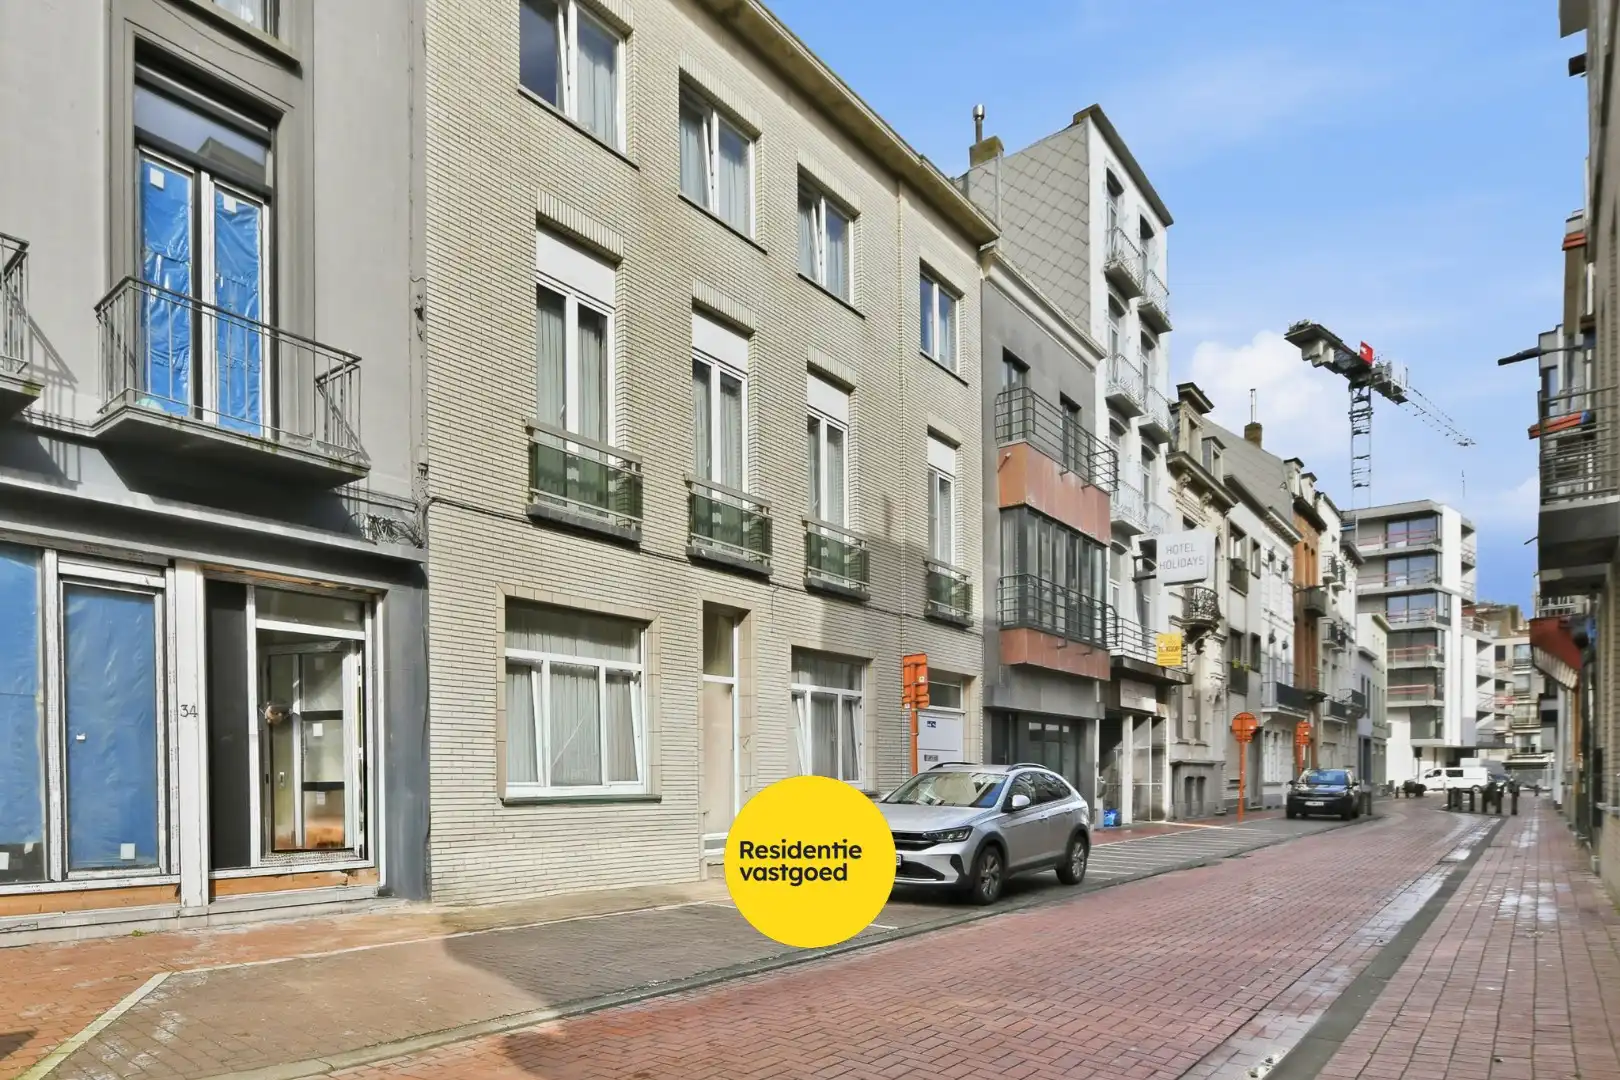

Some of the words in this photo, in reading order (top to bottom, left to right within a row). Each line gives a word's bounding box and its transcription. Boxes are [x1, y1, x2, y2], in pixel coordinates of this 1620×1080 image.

[1165, 543, 1197, 555] HOTEL
[1159, 555, 1206, 570] HOLIDAYS
[180, 704, 199, 718] 34
